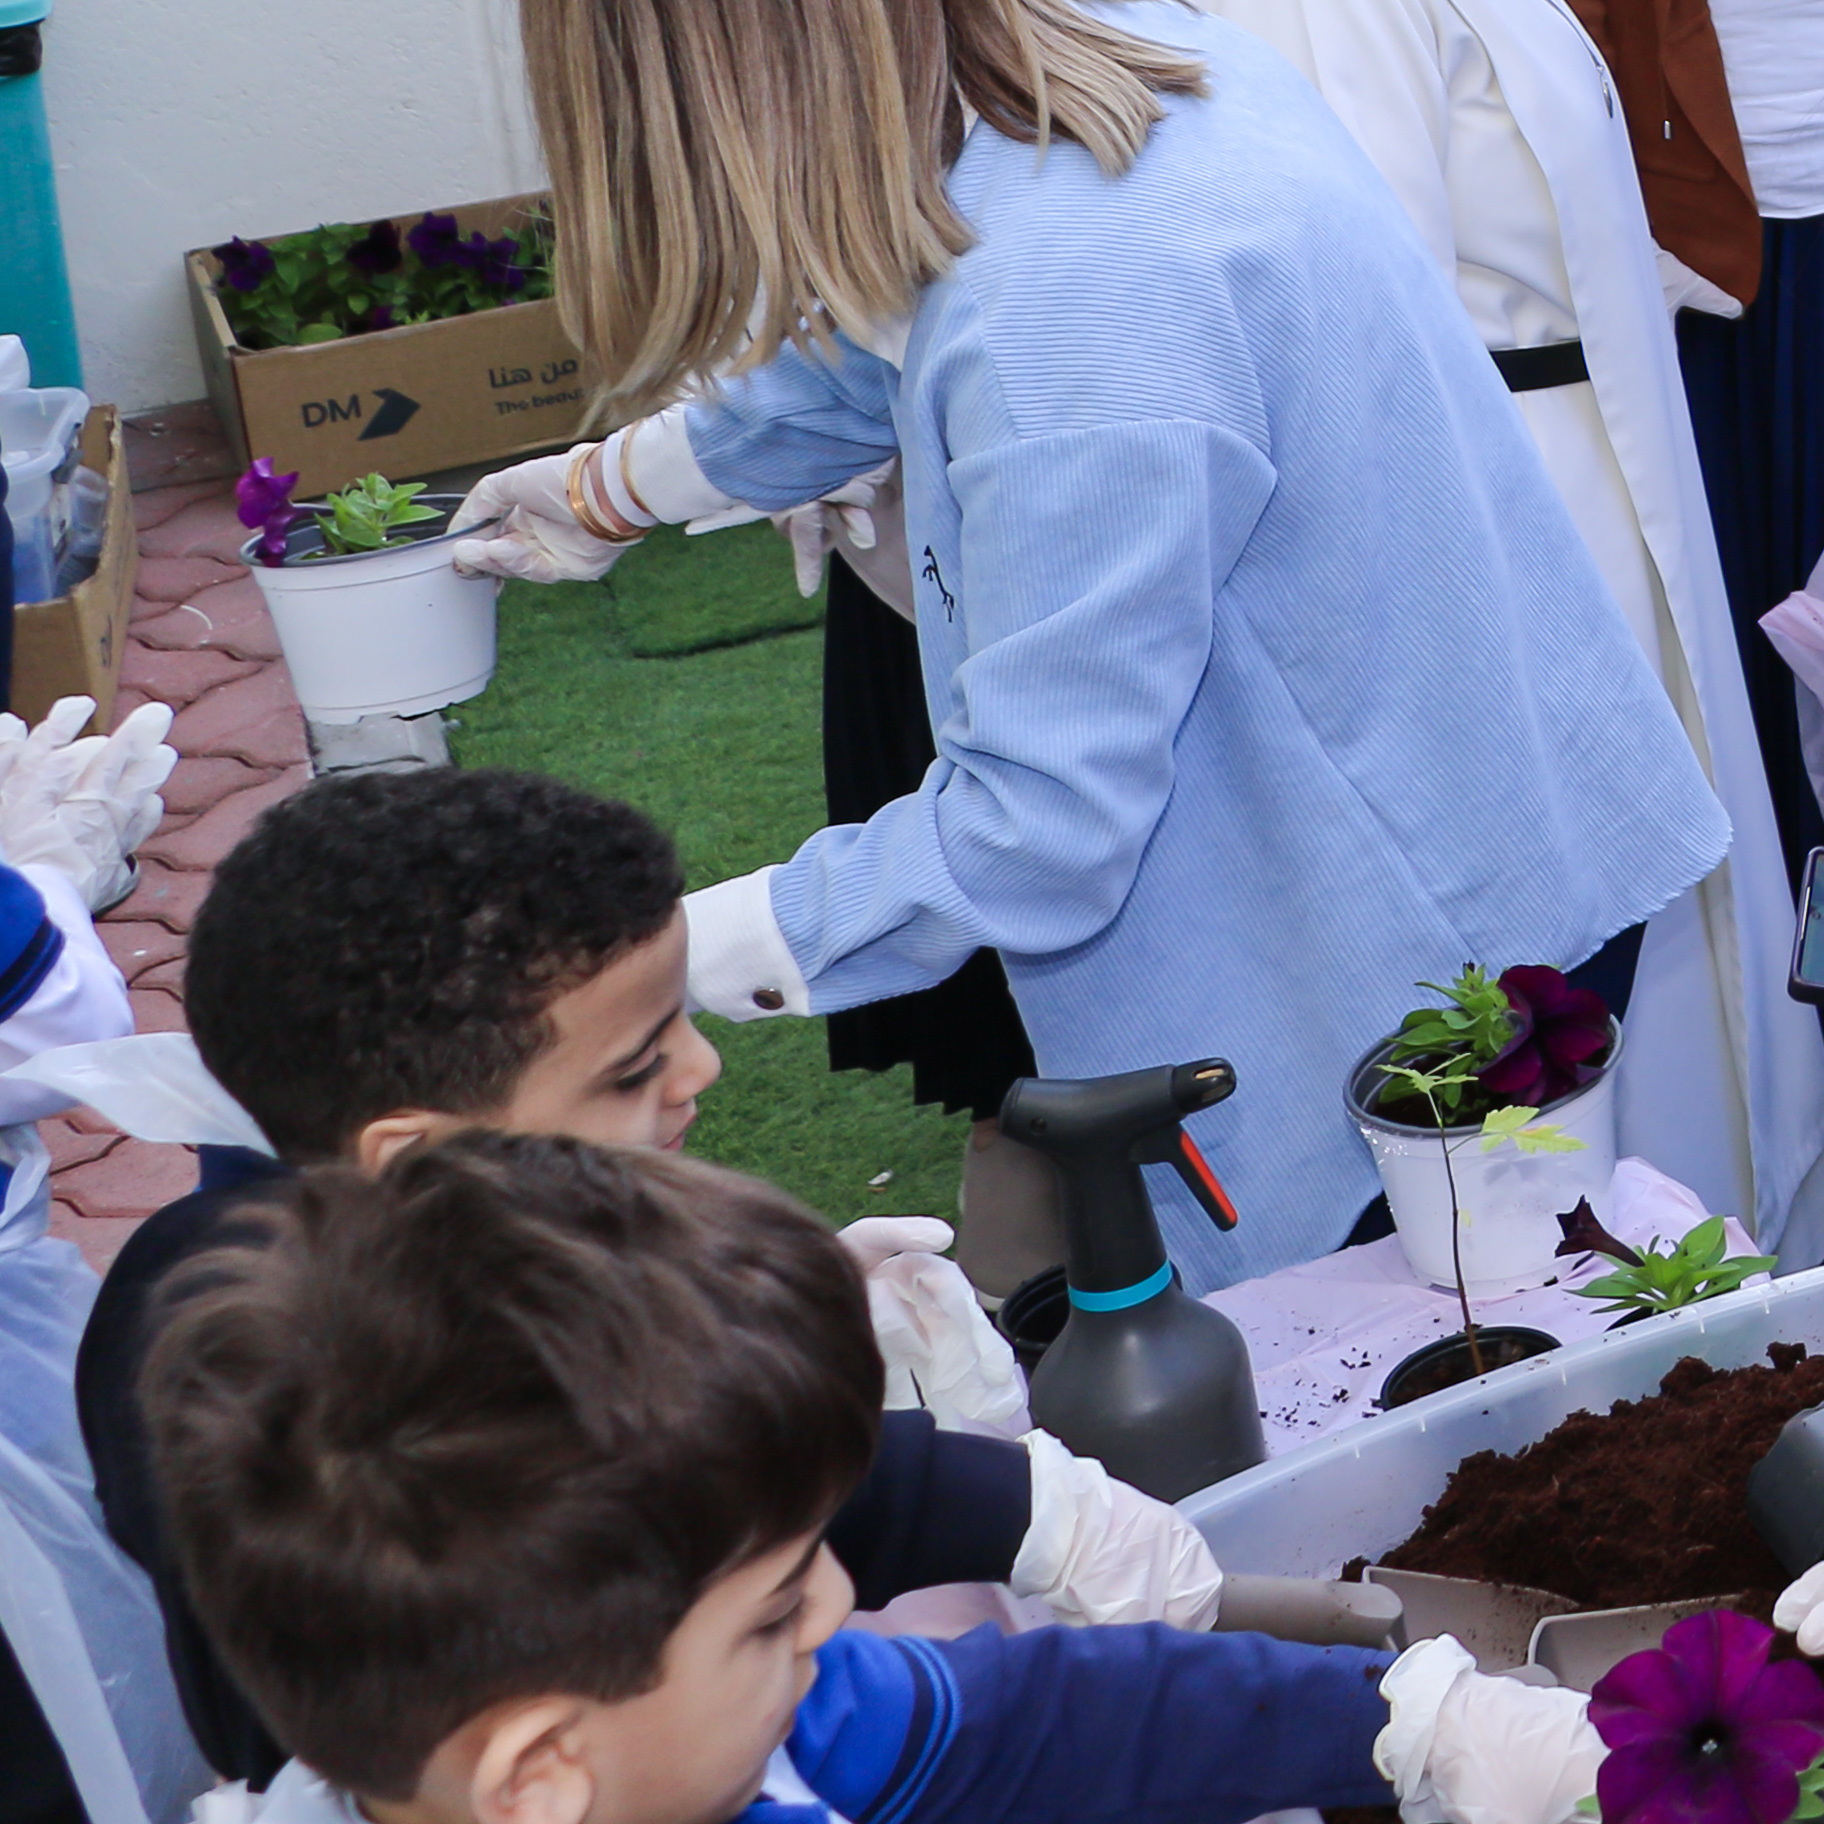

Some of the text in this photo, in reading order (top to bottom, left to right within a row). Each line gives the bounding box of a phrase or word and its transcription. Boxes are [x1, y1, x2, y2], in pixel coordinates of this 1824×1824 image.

[488, 359, 578, 389] من هنا
[301, 393, 362, 428] DM
[495, 387, 584, 415] The beau
